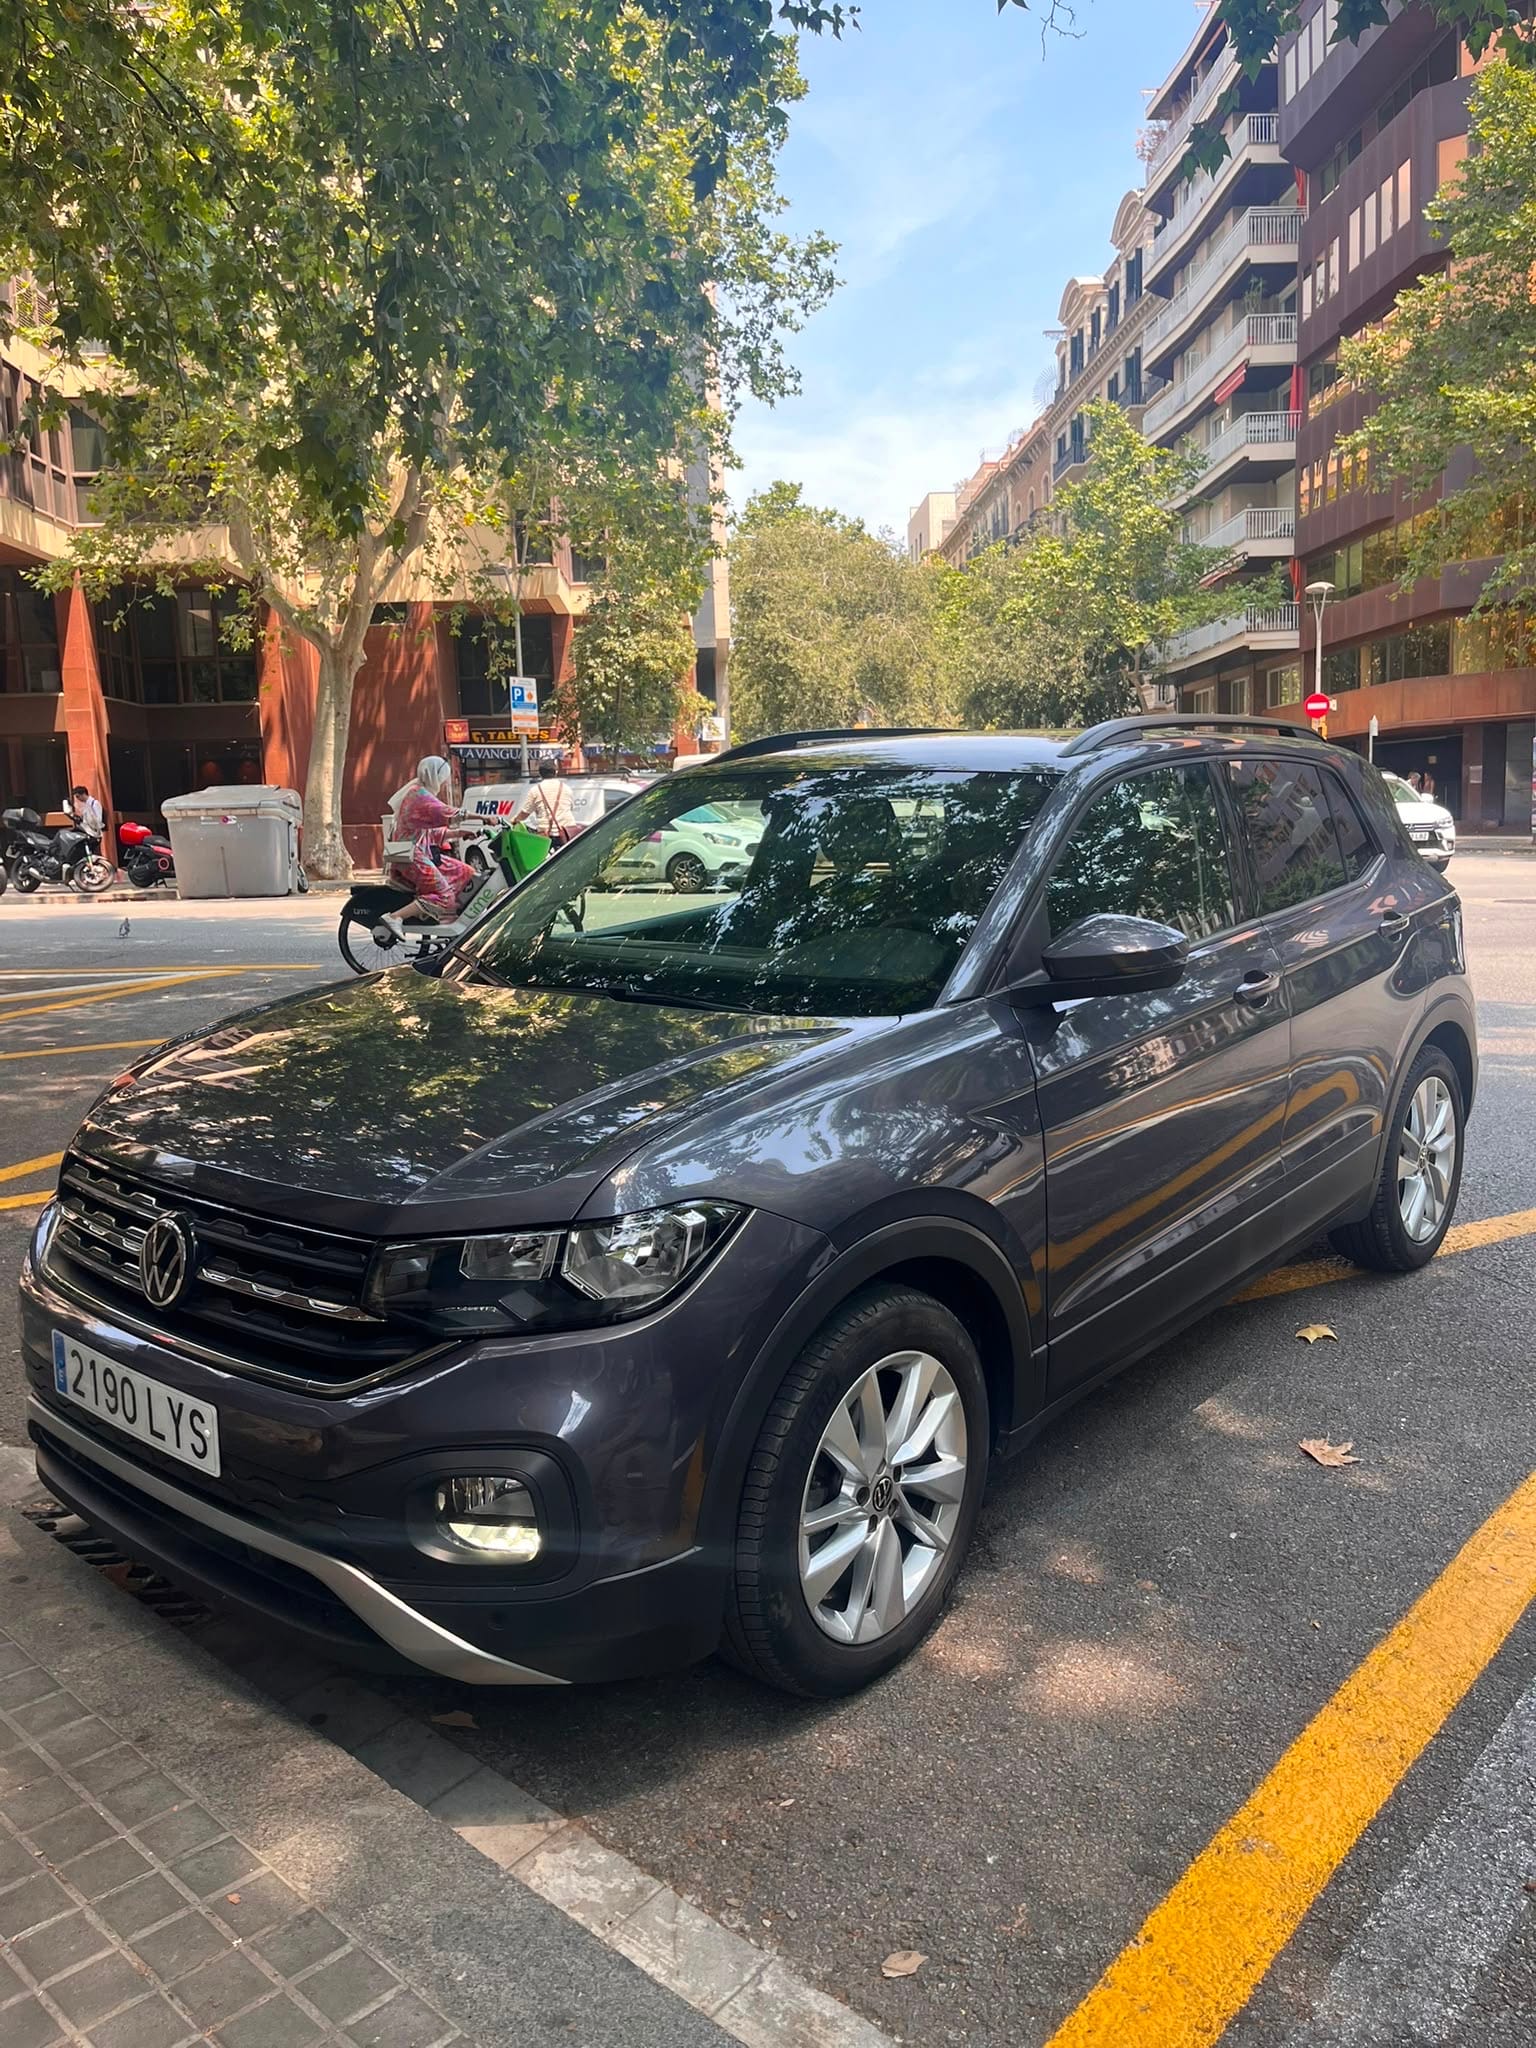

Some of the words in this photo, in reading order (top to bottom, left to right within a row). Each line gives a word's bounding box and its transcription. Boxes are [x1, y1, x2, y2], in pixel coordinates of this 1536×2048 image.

[514, 687, 522, 701] P
[488, 730, 550, 740] TABCS
[460, 748, 474, 759] LA
[476, 748, 555, 760] VANGURDIA
[475, 800, 515, 816] MRW
[463, 888, 494, 920] Lime
[70, 1349, 137, 1425] 2190
[146, 1386, 209, 1460] LYS
